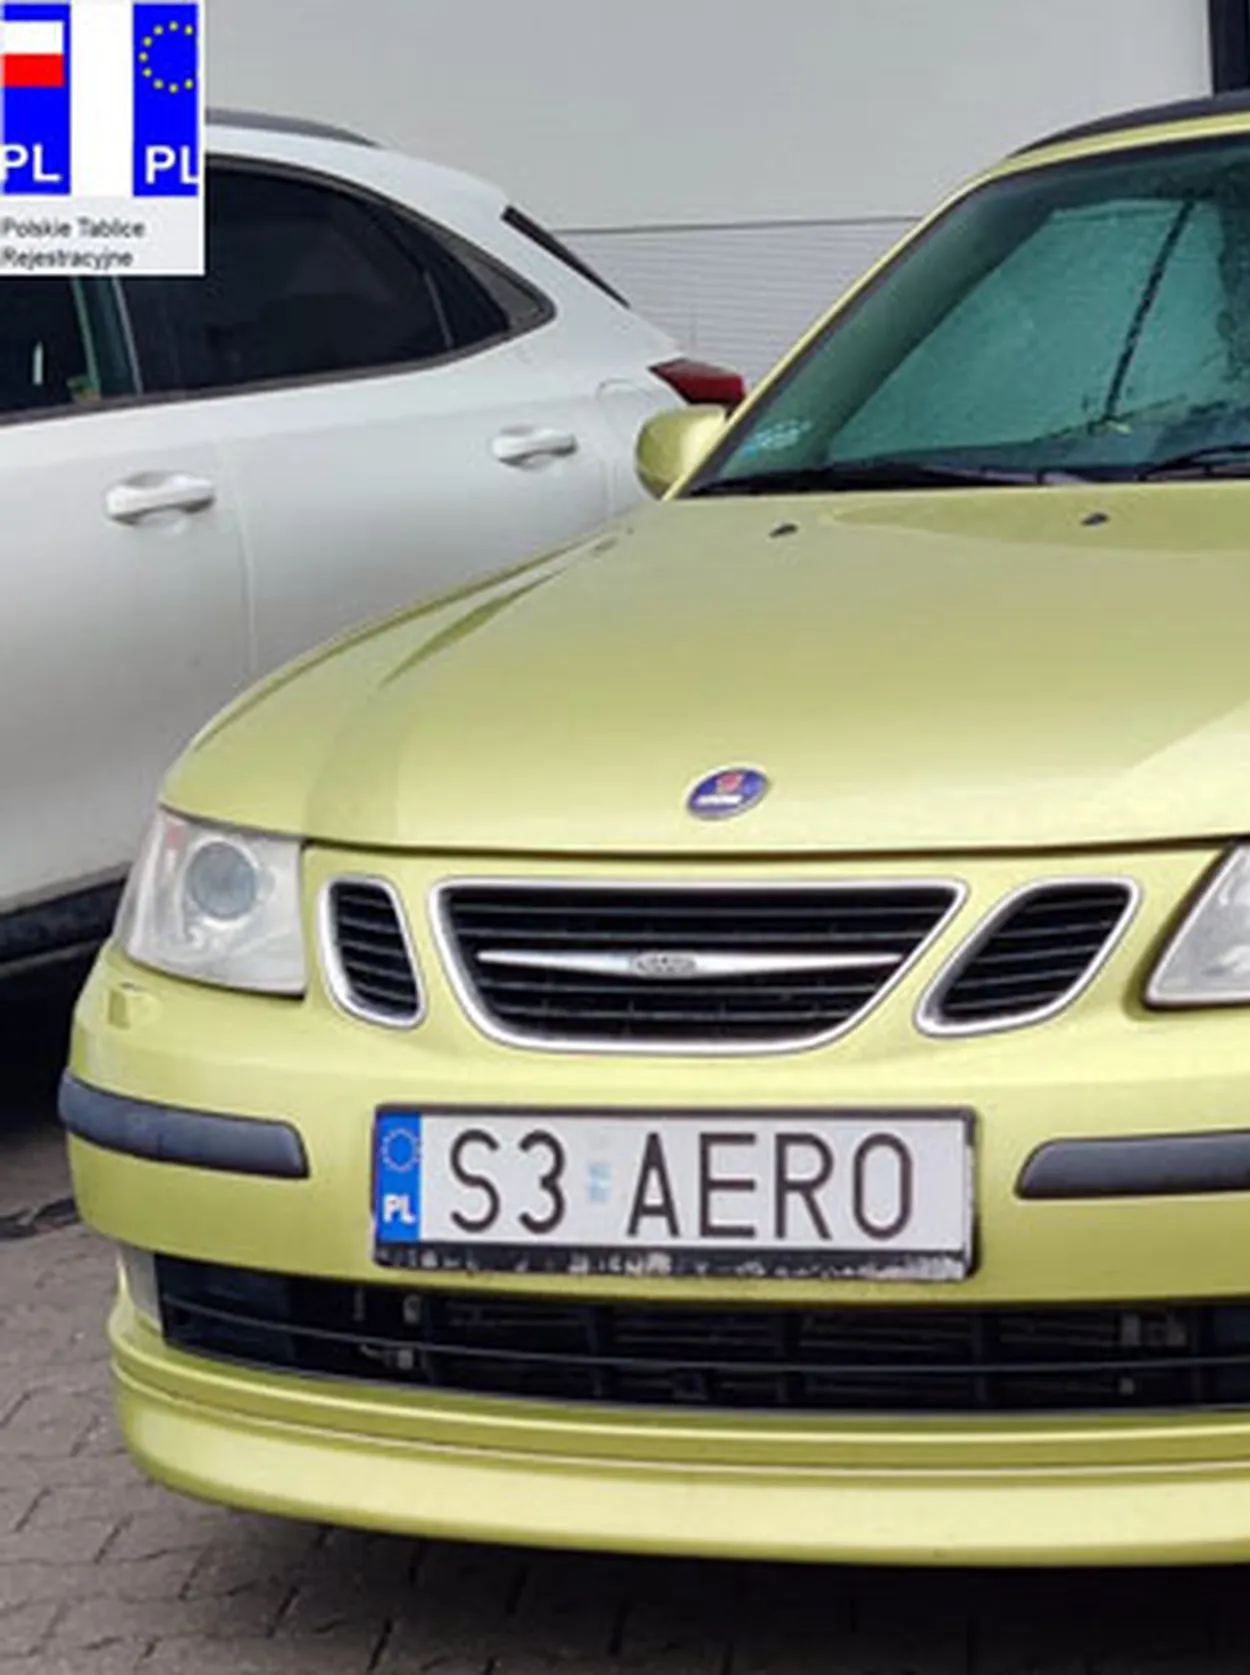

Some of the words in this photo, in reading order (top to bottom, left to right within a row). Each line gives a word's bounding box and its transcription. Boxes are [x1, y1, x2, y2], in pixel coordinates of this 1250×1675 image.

[383, 1194, 417, 1223] PL
[449, 1129, 566, 1233] S3
[626, 1131, 914, 1240] AERO
